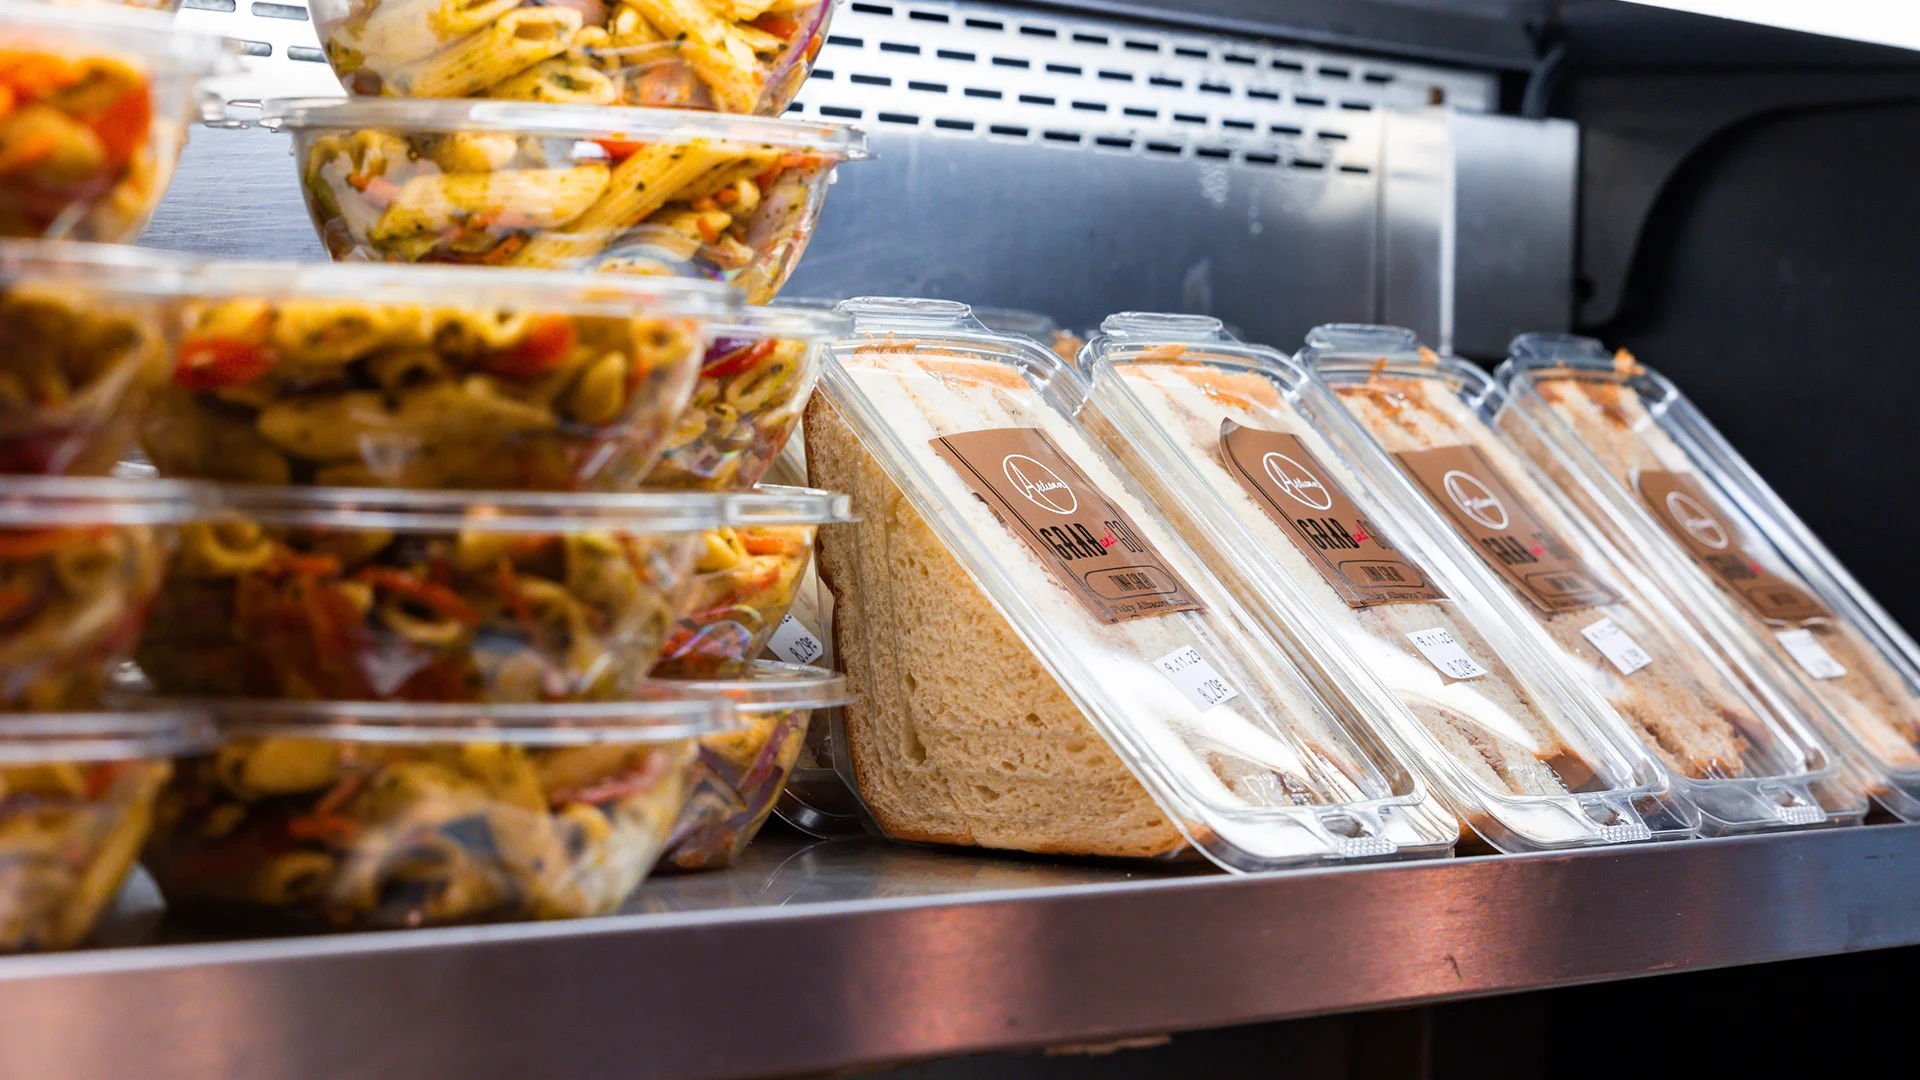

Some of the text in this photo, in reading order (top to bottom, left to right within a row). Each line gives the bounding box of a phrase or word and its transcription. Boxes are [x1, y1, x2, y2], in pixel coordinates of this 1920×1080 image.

[1040, 520, 1144, 560] GRAB and GO
[1297, 518, 1359, 549] GRAB
[1108, 574, 1137, 592] TUNA
[1137, 600, 1172, 610] Albacore
[1164, 649, 1201, 673] 9.11.23
